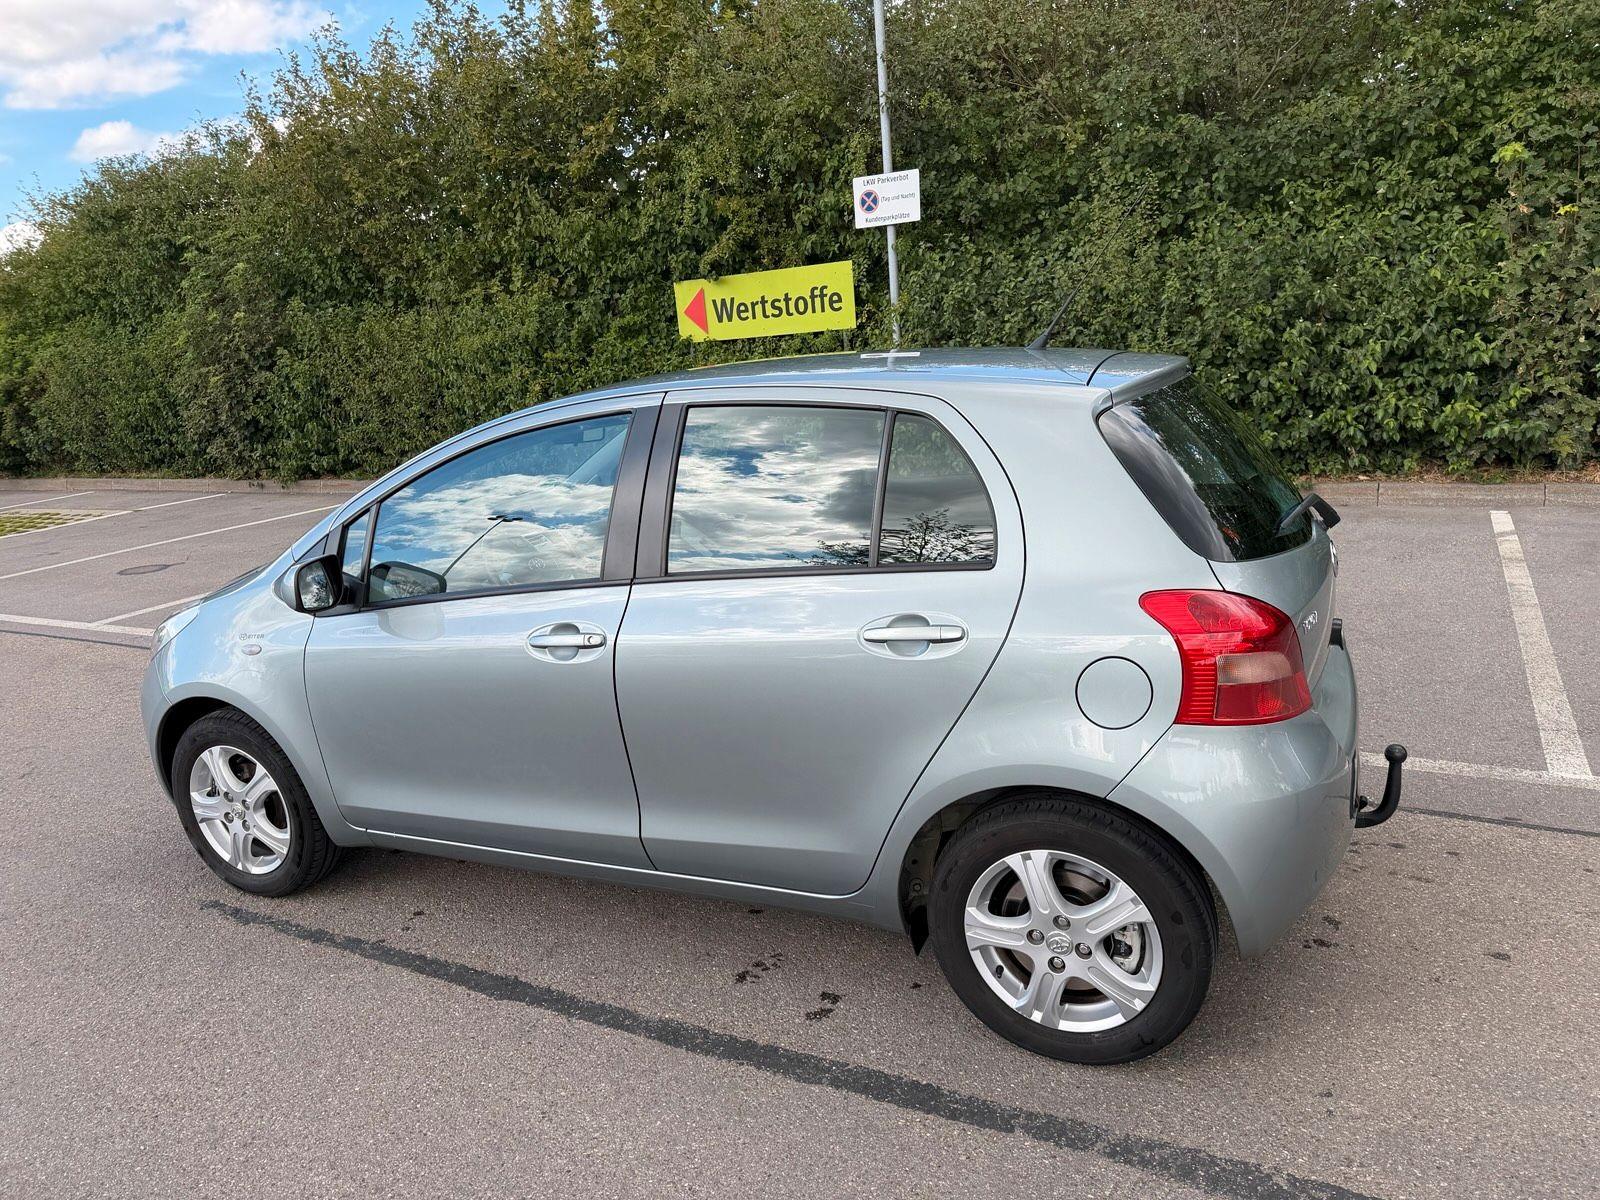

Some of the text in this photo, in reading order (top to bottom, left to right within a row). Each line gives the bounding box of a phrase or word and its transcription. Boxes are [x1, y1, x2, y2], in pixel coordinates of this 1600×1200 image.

[863, 174, 909, 187] LKW Parkverbot
[865, 212, 910, 223] Kundenparkplätze
[711, 285, 843, 324] Wertstoffe
